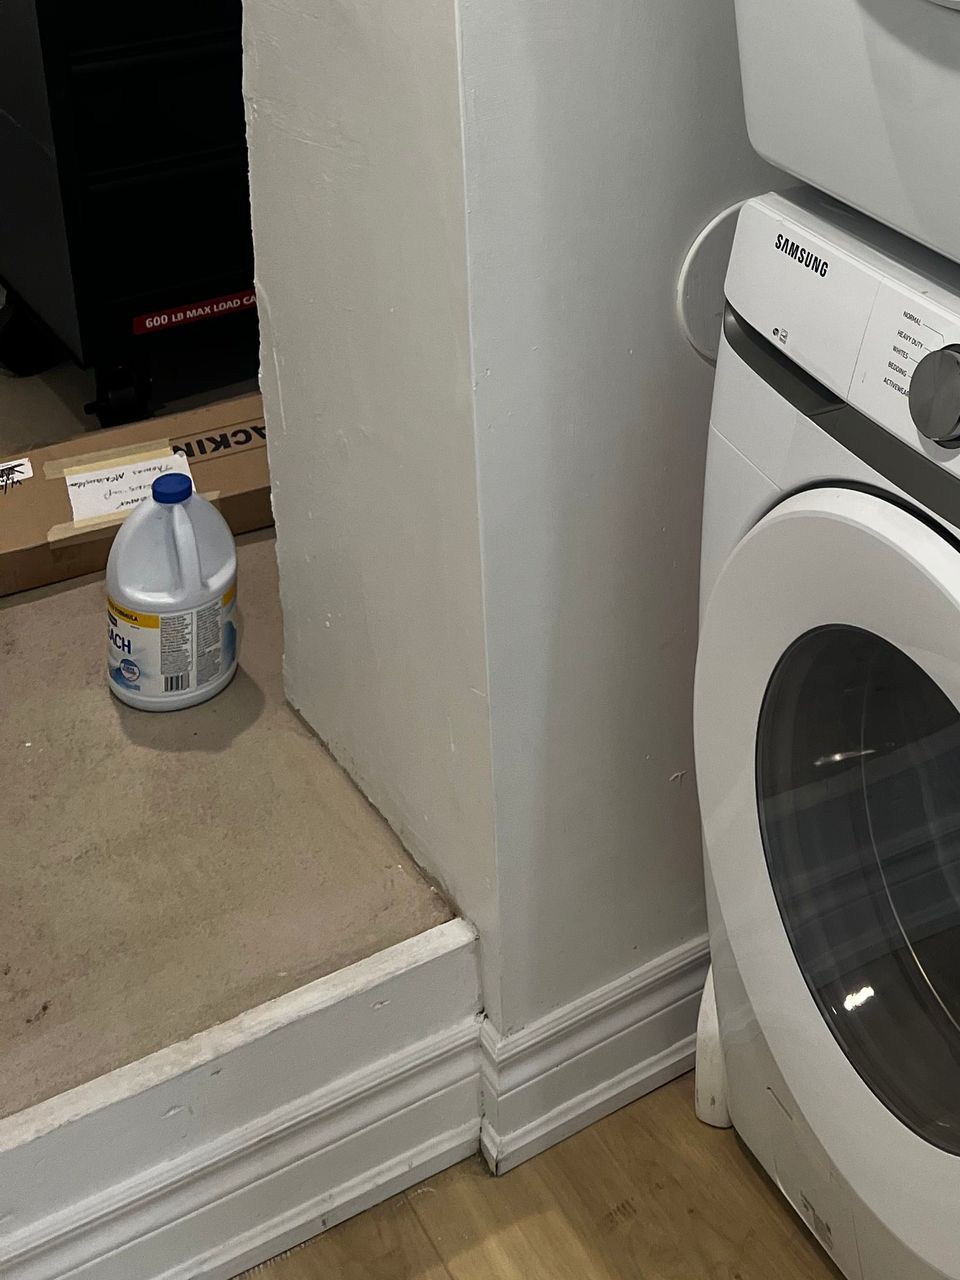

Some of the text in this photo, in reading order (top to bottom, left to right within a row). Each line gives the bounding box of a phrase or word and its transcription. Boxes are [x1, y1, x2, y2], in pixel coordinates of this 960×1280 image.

[775, 234, 828, 277] SAMSUNG
[146, 314, 168, 328] 600
[172, 312, 184, 322] LB
[186, 306, 211, 318] MAX
[214, 299, 240, 312] LOAD
[903, 310, 922, 326] NORMAL
[897, 329, 924, 350] HEAVY DUTY
[892, 345, 908, 360] WHITES
[888, 360, 907, 378] BEDDING
